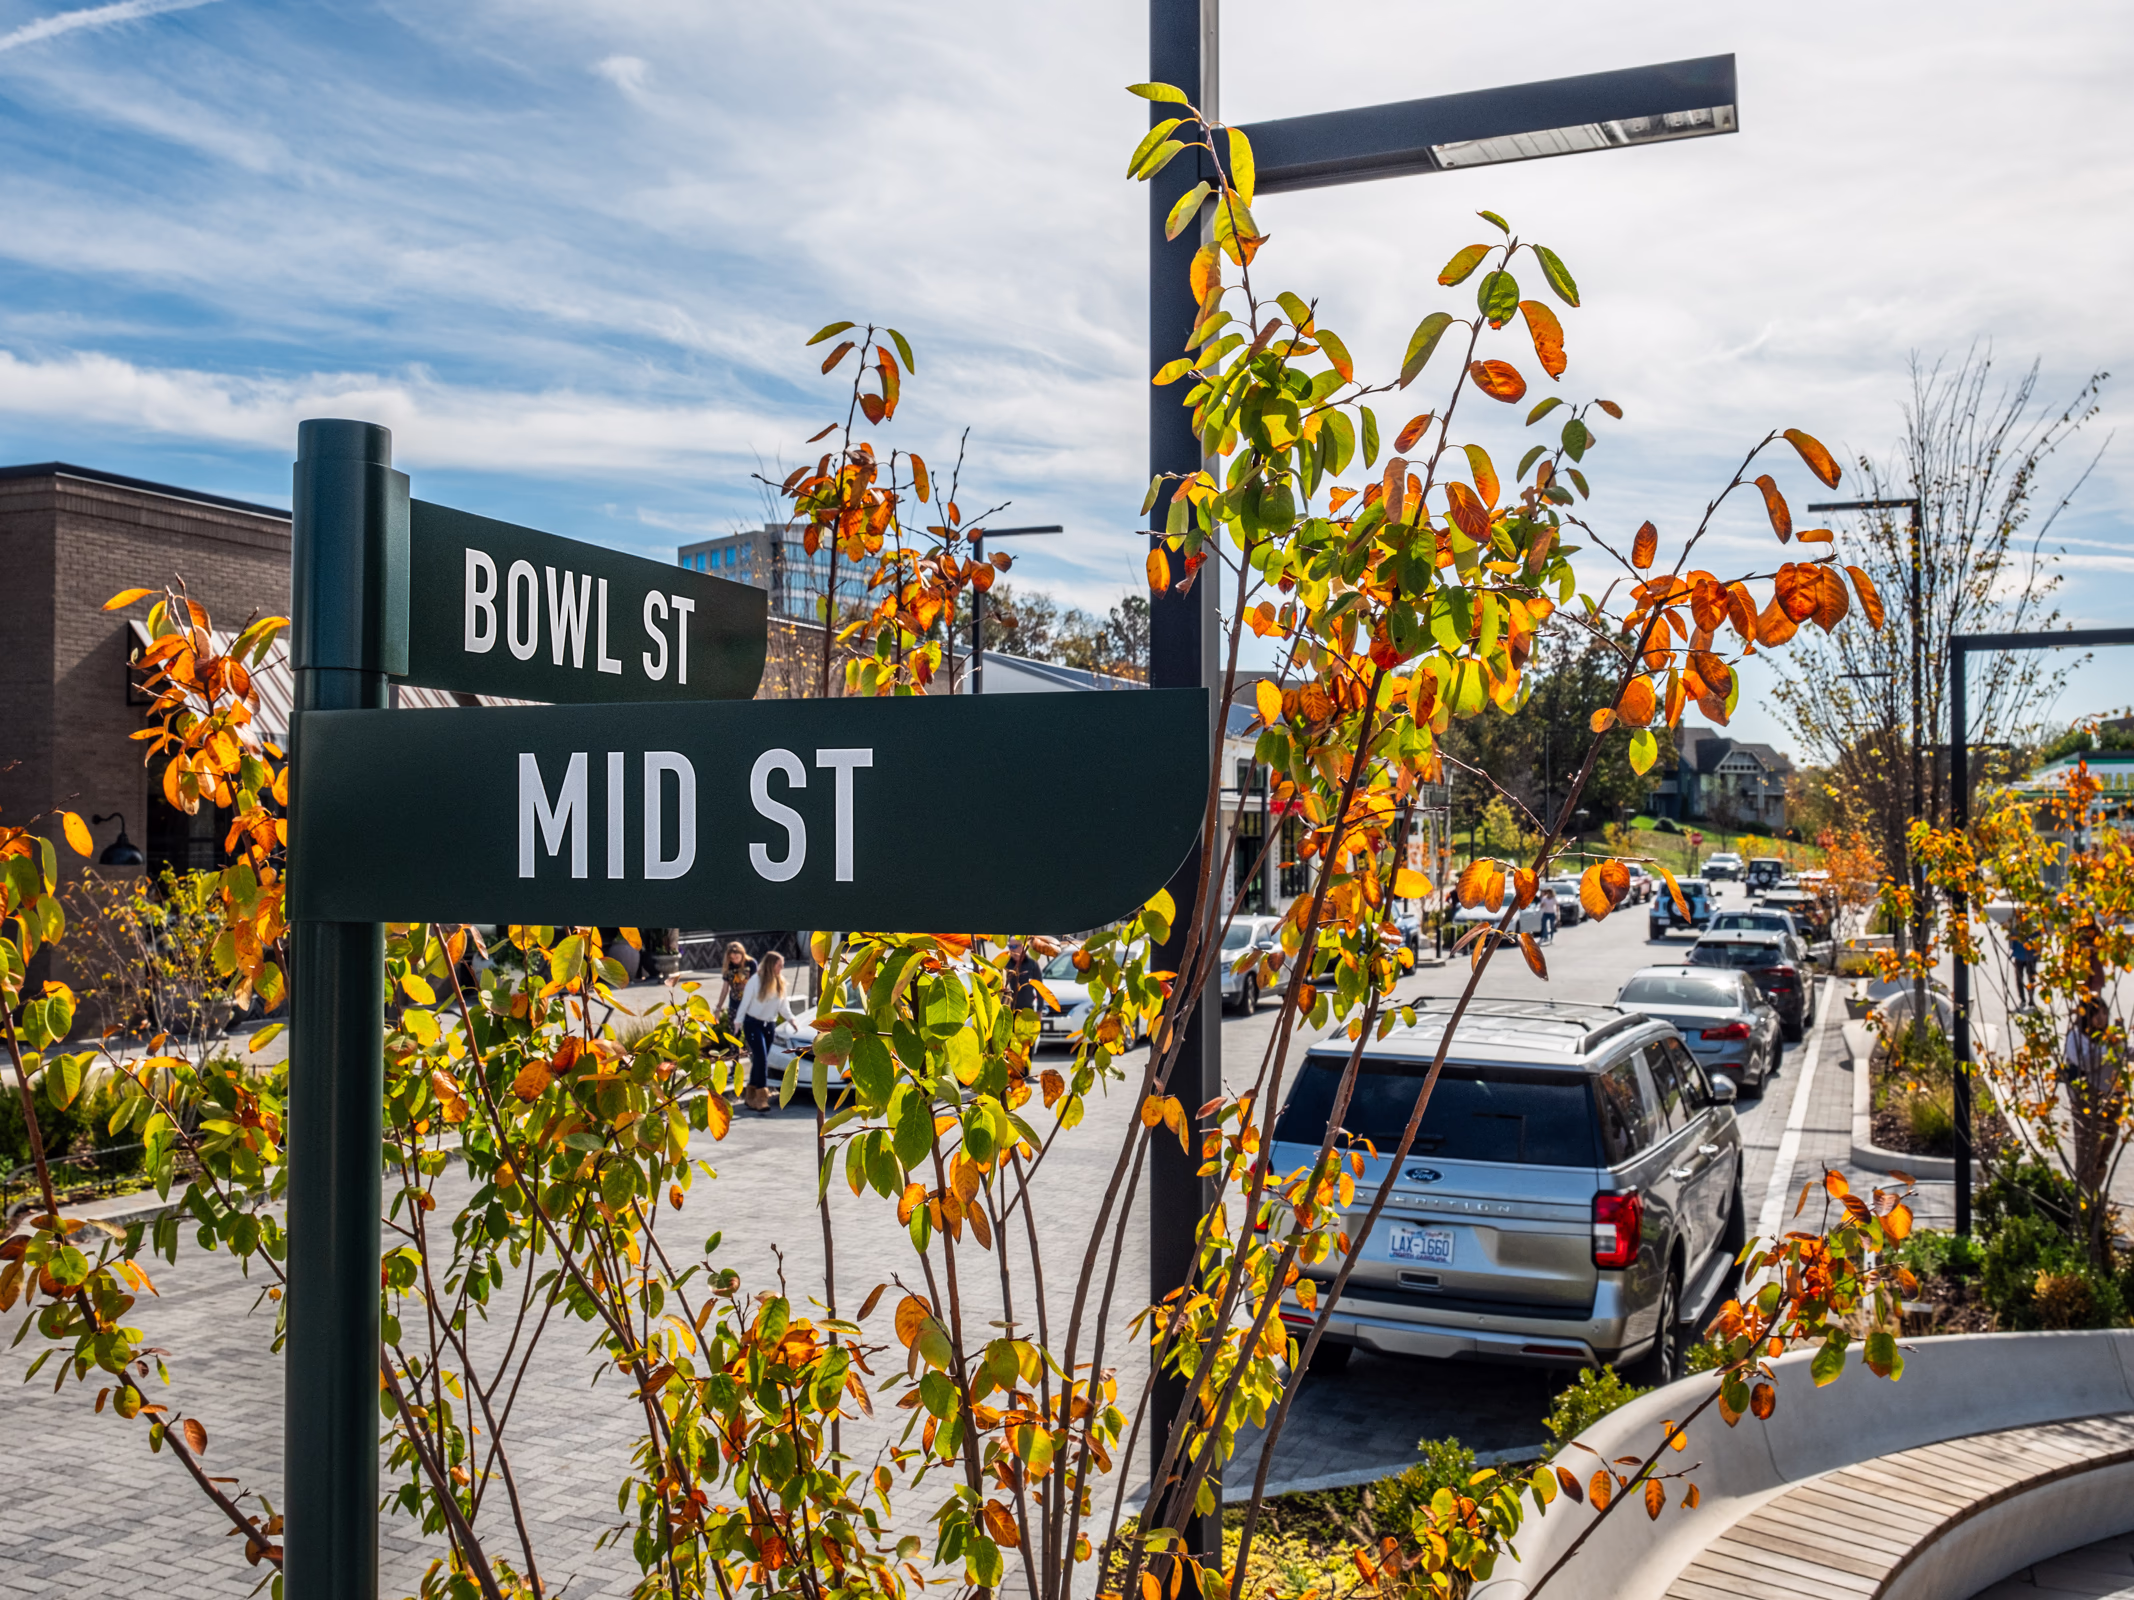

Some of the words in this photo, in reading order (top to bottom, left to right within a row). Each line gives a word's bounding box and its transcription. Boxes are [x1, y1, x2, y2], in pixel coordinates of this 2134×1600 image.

[463, 547, 623, 676] BOWL
[642, 589, 695, 685] ST
[518, 751, 697, 880] MID
[749, 748, 874, 883] ST
[1391, 1235, 1450, 1257] LAX-1660
